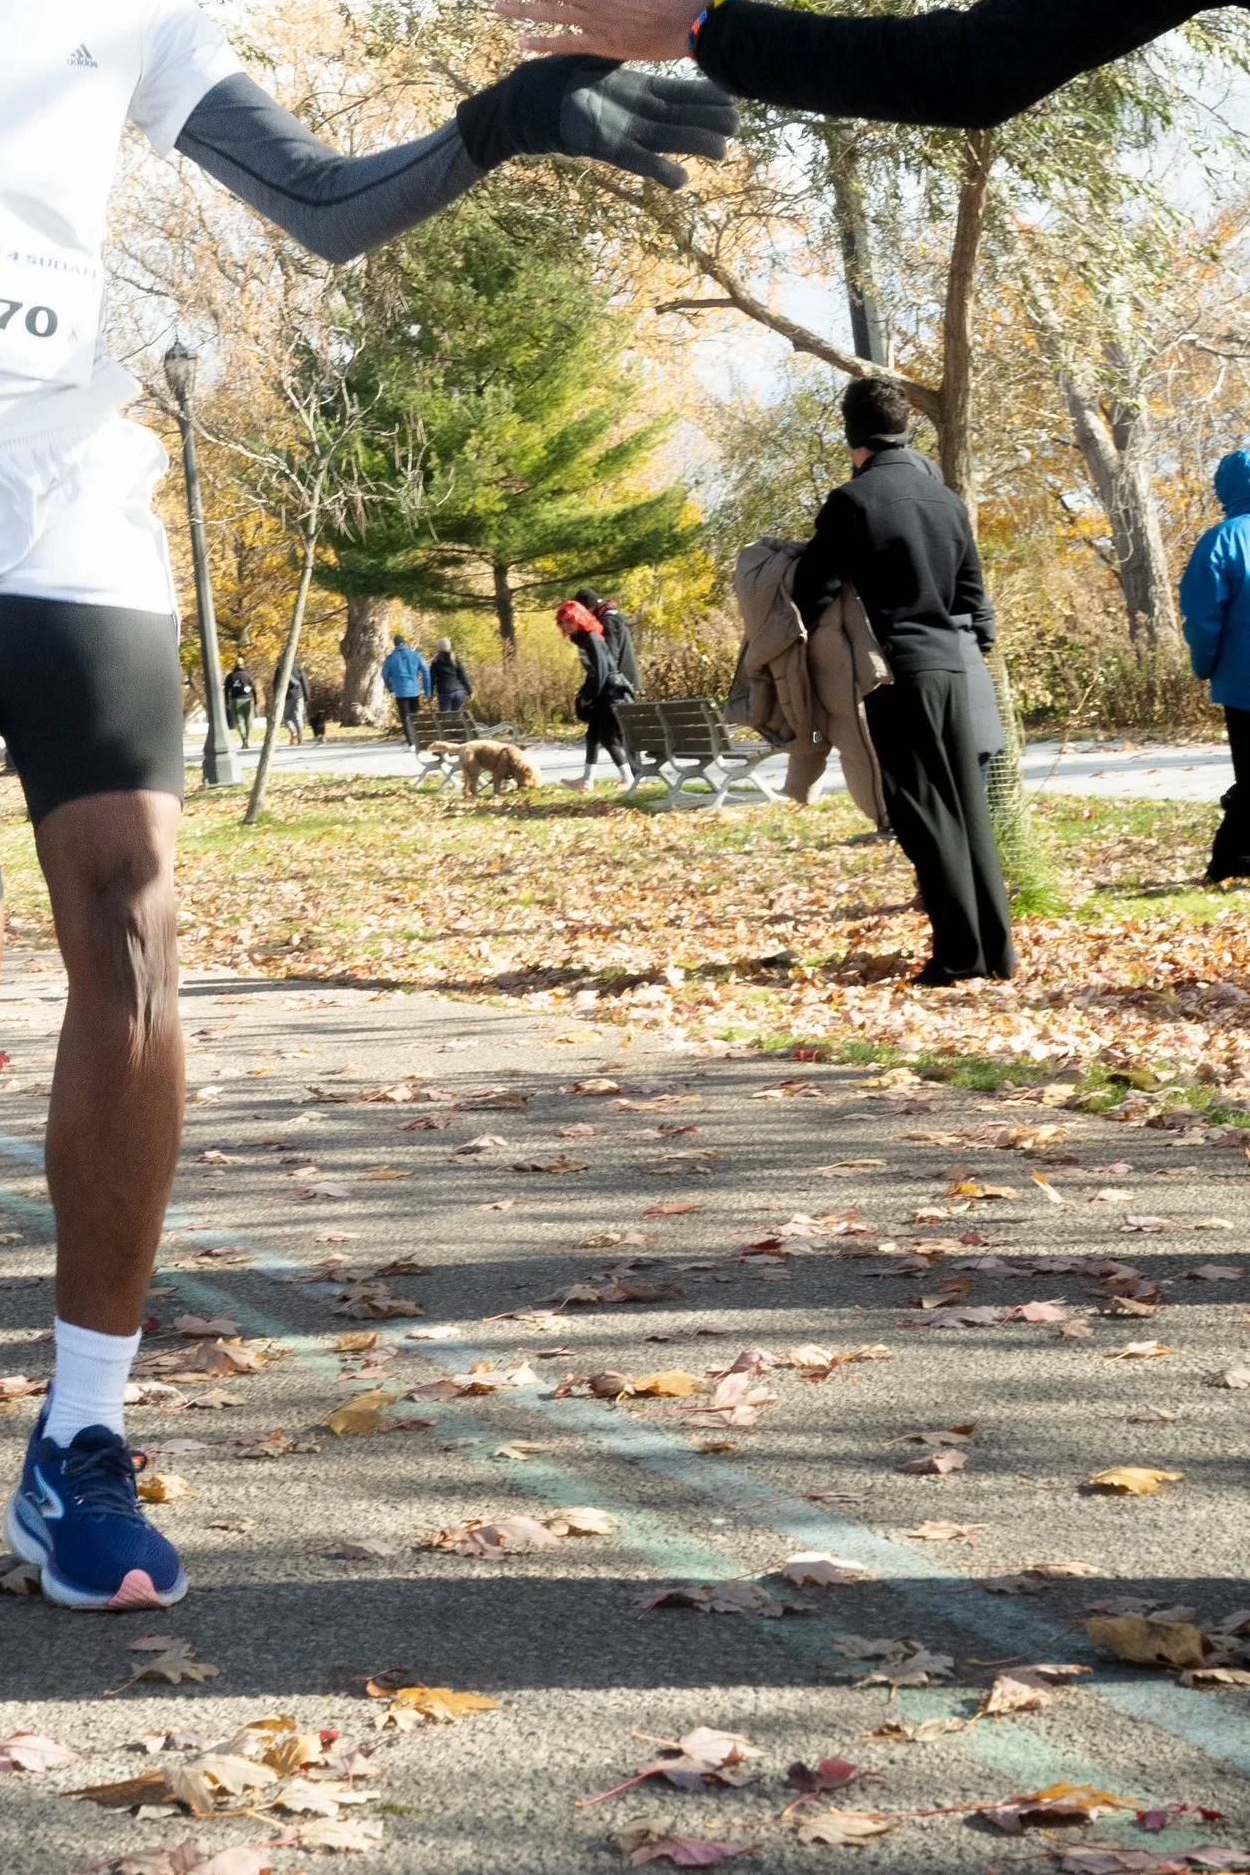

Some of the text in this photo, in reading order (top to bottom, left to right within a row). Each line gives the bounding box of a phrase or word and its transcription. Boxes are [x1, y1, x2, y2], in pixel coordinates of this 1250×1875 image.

[66, 56, 98, 69] adidas
[8, 251, 19, 261] 4
[26, 254, 96, 278] SUDAN
